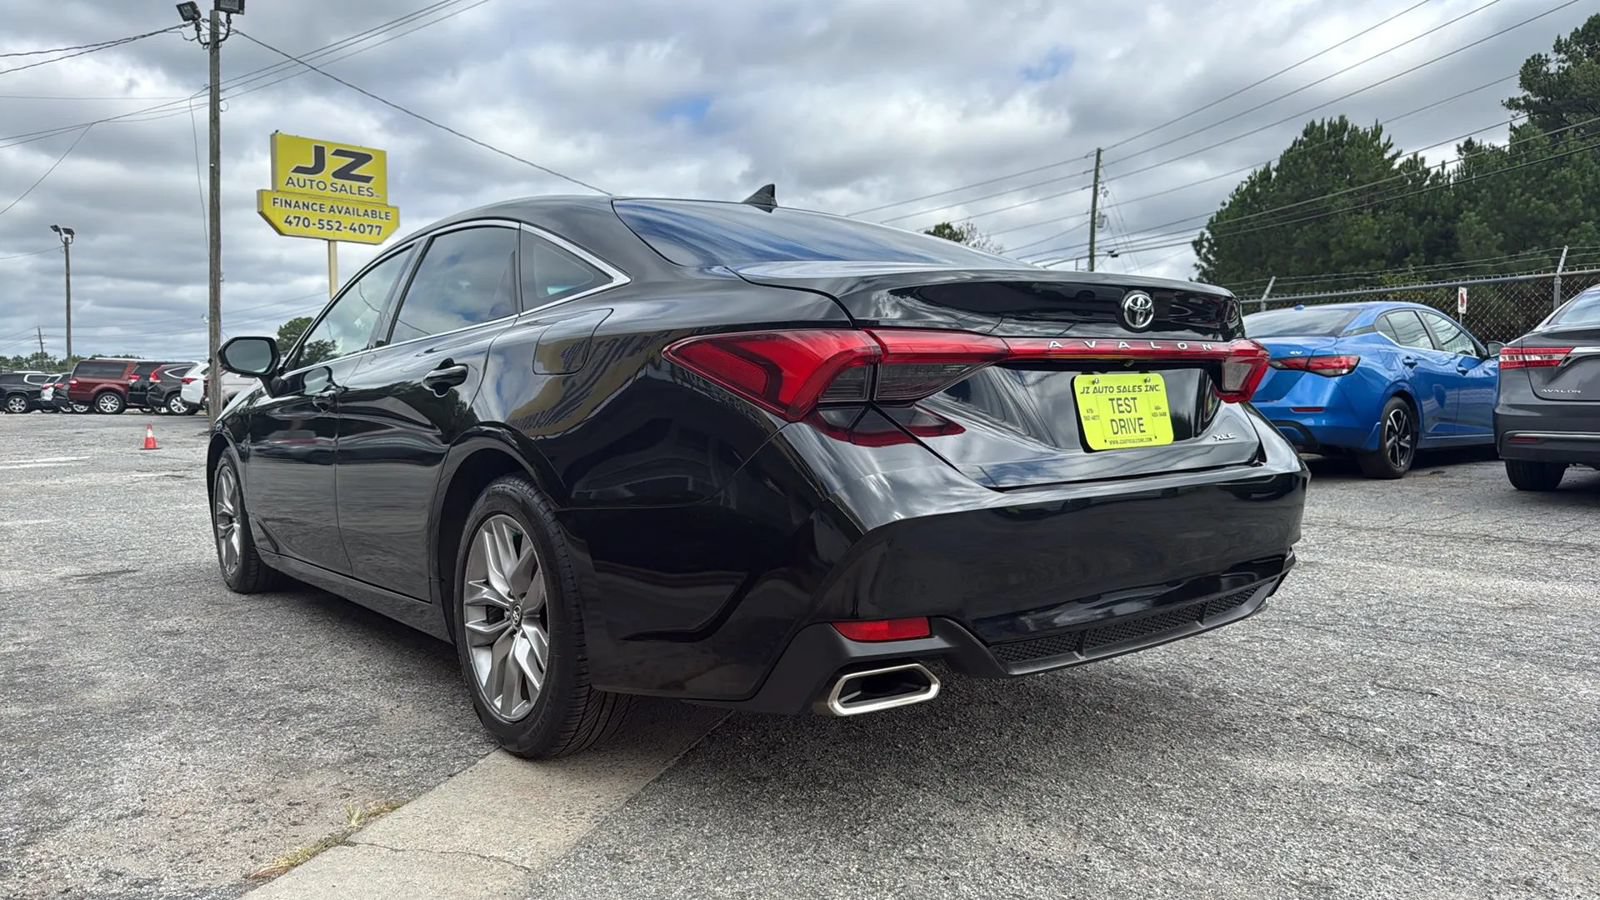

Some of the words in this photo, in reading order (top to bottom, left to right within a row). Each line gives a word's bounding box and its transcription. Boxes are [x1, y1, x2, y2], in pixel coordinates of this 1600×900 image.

[291, 145, 375, 184] JZ
[285, 176, 327, 191] AUTO
[330, 182, 374, 198] SALES
[272, 197, 326, 213] FINANCE
[328, 205, 391, 220] AVAILABLE
[284, 215, 382, 236] 470-552-4077
[1049, 340, 1212, 351] AVALON
[1080, 386, 1091, 394] JZ
[1092, 385, 1115, 394] AUTO
[1116, 384, 1143, 394] SALES
[1144, 384, 1161, 393] INC.
[1108, 397, 1138, 414] TEST
[1110, 417, 1146, 435] DRIVE
